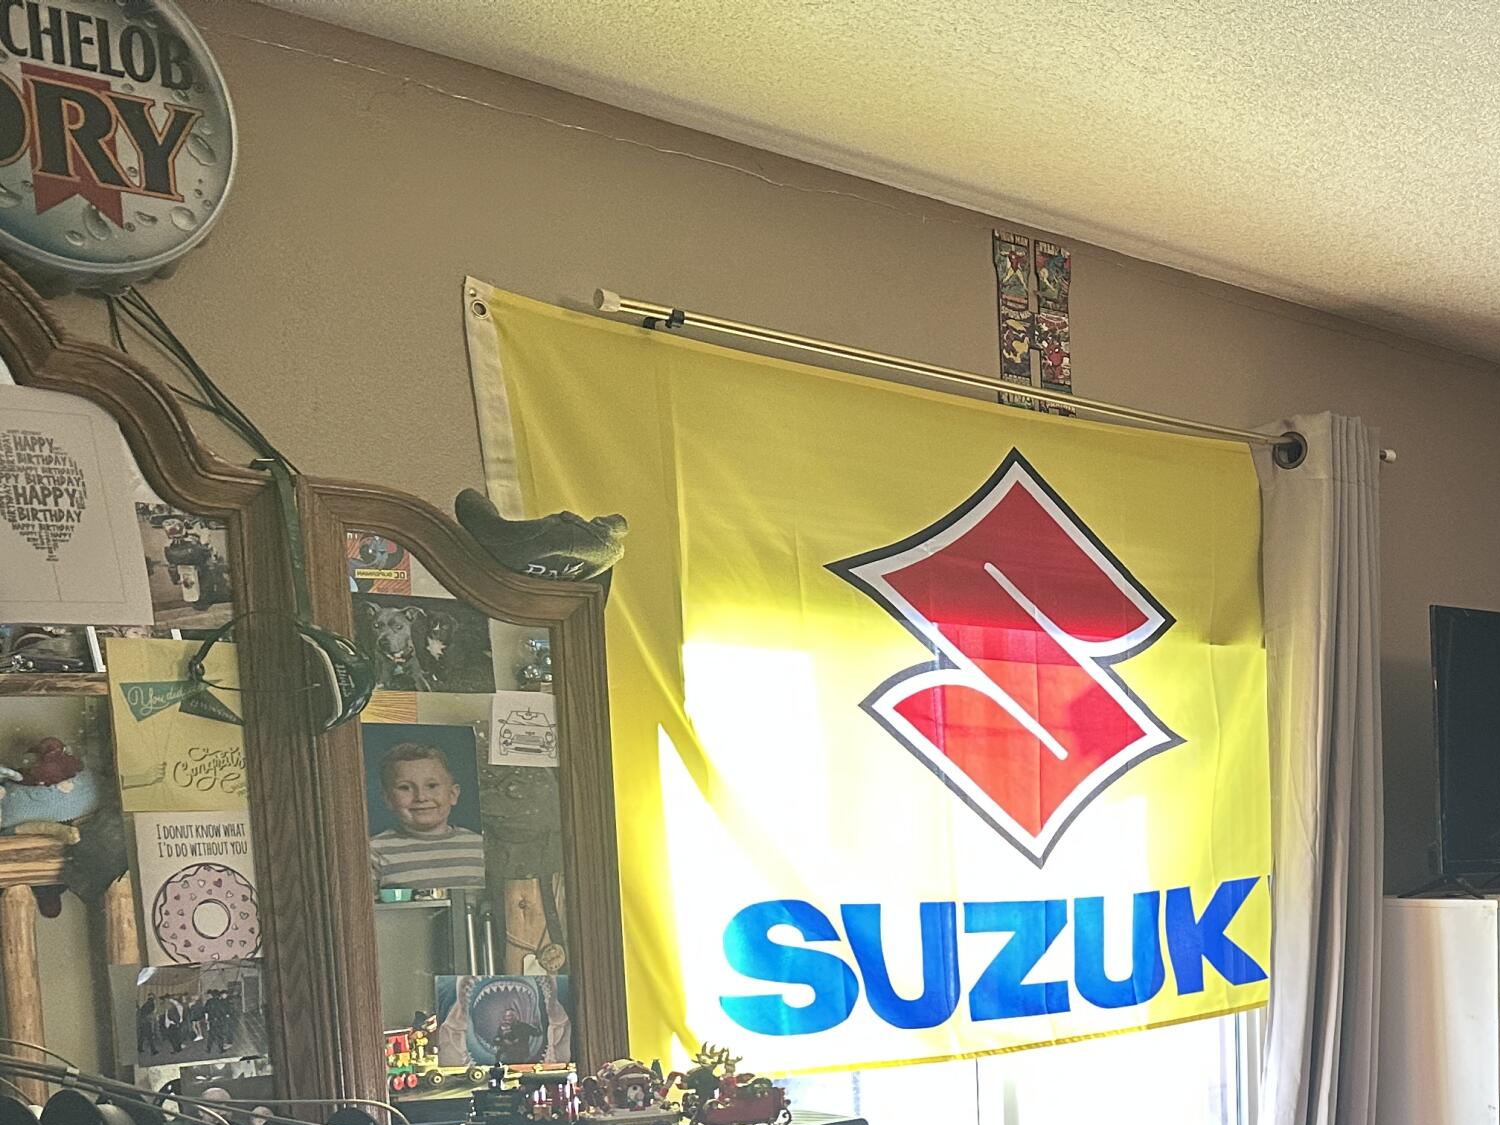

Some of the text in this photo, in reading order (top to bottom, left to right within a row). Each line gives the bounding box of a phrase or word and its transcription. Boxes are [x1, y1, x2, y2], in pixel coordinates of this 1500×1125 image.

[12, 434, 54, 453] HAPPY
[16, 452, 67, 467] BIRTHDAY
[25, 473, 81, 487] BIRTHDAY
[12, 485, 77, 507] HAPPY
[17, 506, 82, 523] BIRTHDAY
[156, 823, 246, 840] I DONUT KNOW WHAT
[157, 840, 248, 858] I'D DO WITHOUT YOU
[718, 875, 1271, 1036] SUZUK
